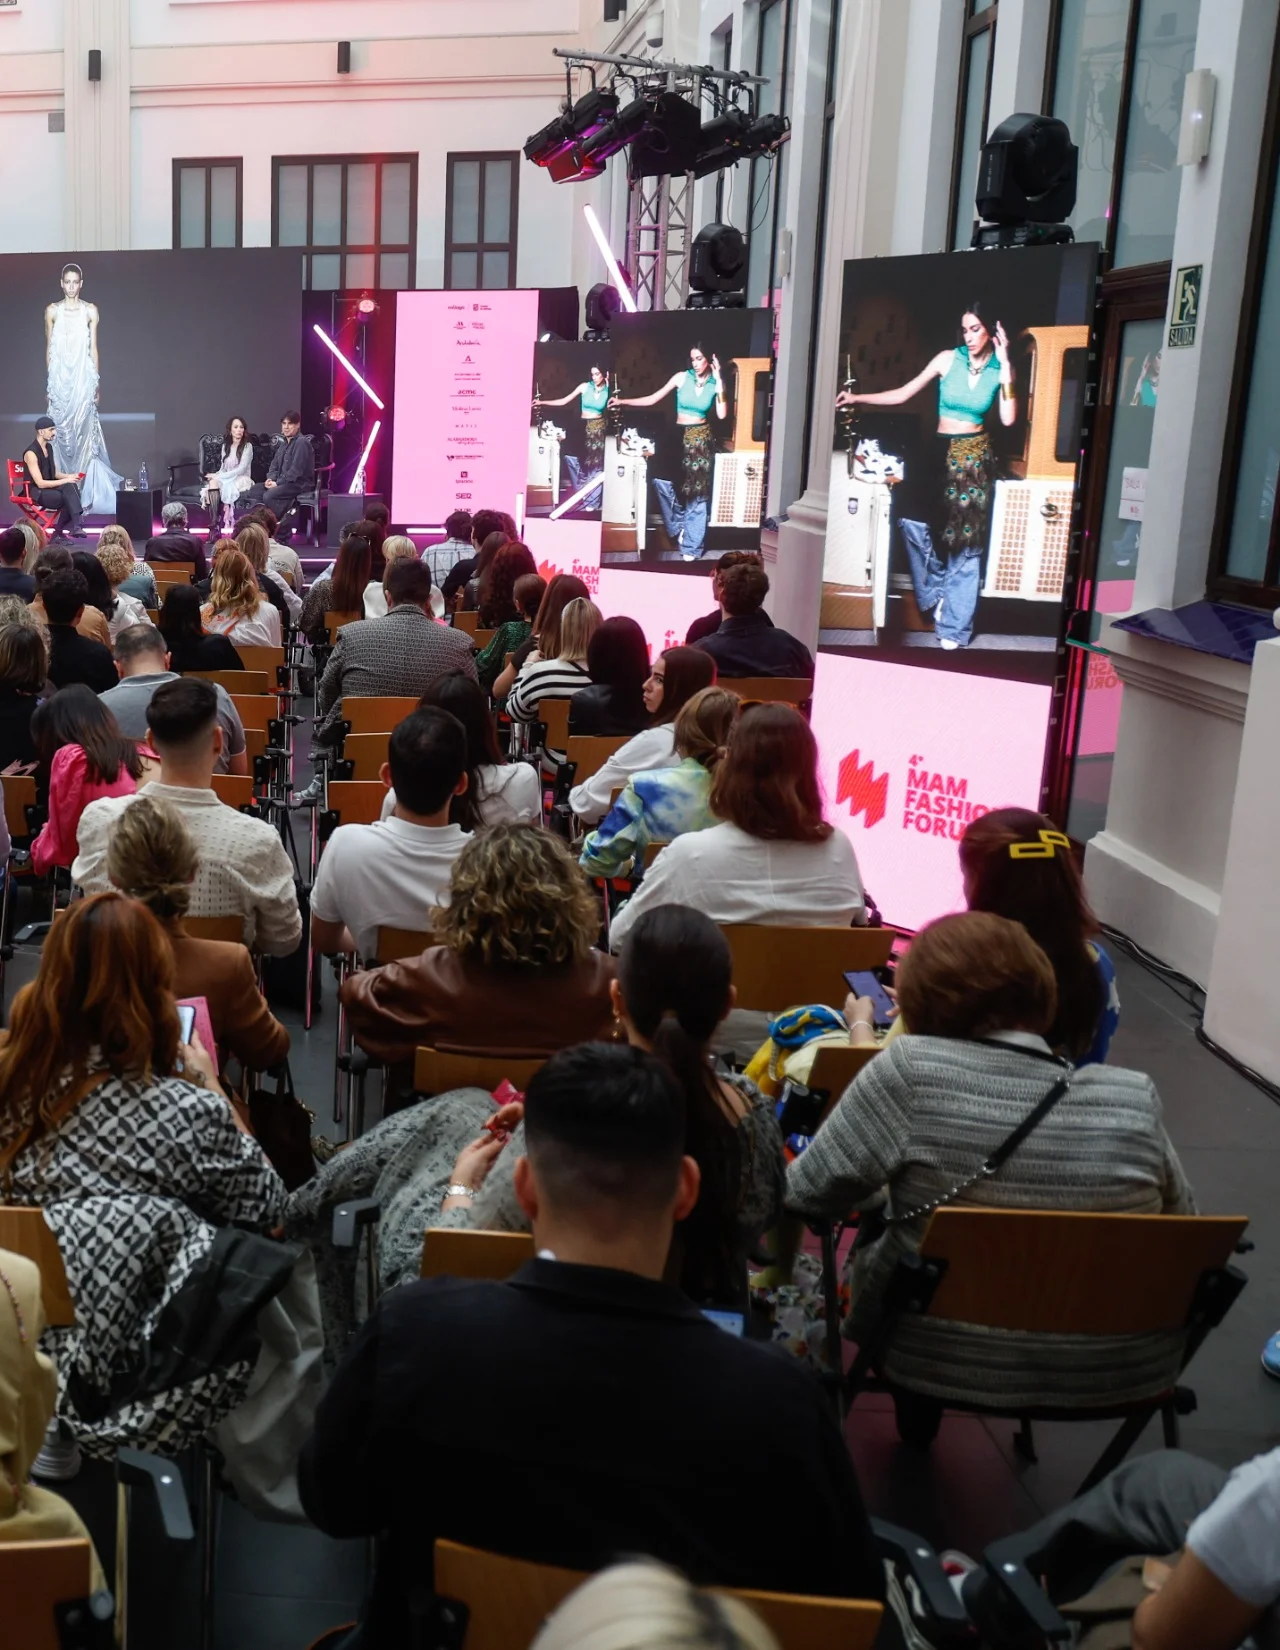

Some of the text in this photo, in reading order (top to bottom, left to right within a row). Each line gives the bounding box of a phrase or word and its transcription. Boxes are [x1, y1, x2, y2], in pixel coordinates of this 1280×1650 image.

[1170, 327, 1195, 346] SALIDA
[572, 565, 600, 575] MAM
[907, 767, 968, 800] MAM
[904, 789, 996, 822] FASHIO
[902, 810, 967, 842] FORU
